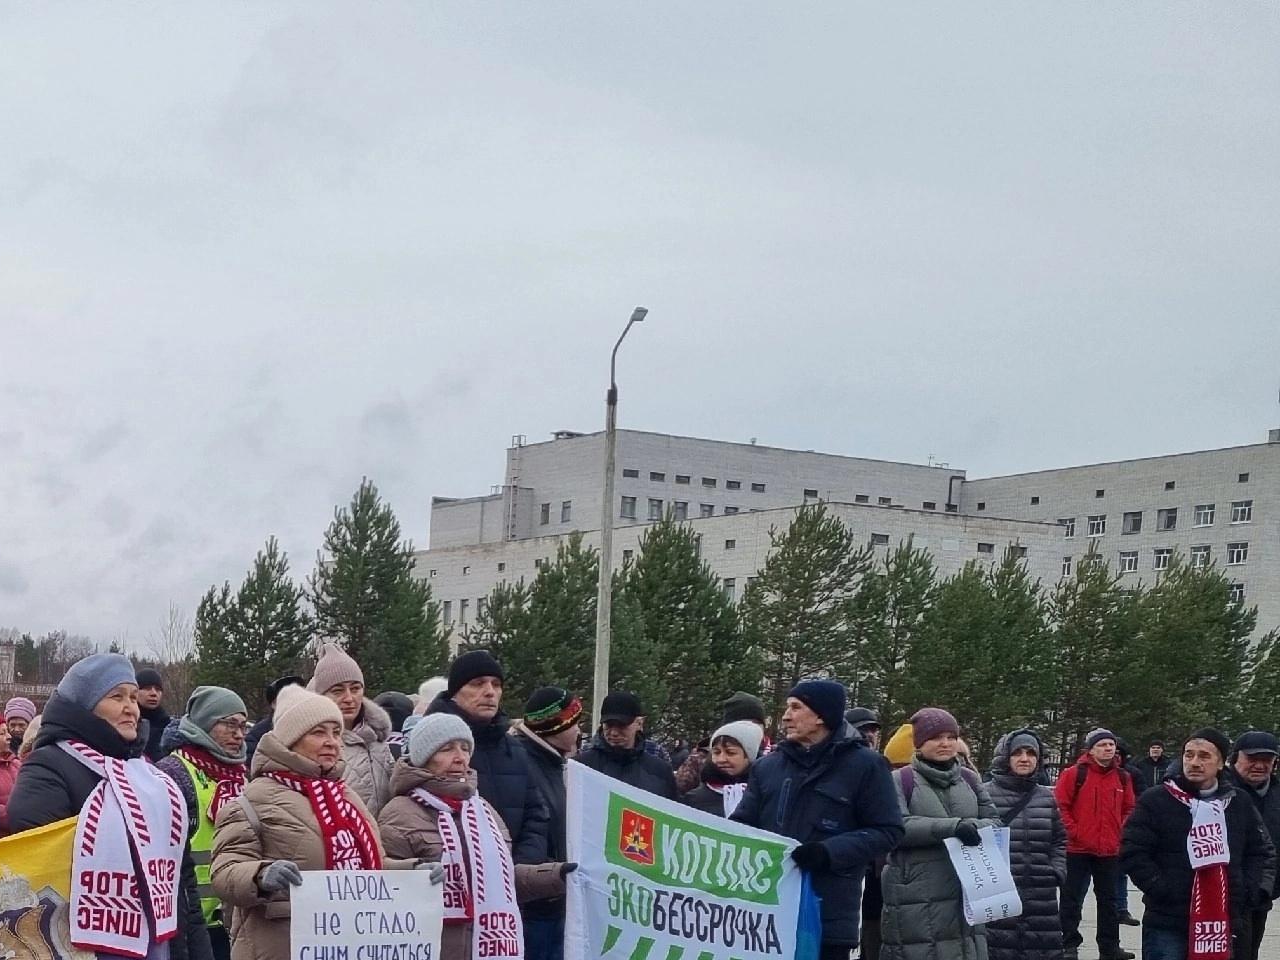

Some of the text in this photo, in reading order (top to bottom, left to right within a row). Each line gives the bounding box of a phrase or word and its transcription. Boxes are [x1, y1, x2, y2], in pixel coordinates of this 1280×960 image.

[660, 823, 773, 894] КОТЛАС
[326, 875, 400, 901] НАРОД-
[606, 872, 783, 955] ЭКОБЕССРОЧКА
[1195, 921, 1226, 934] STOP
[1194, 939, 1227, 954] ШИЕС
